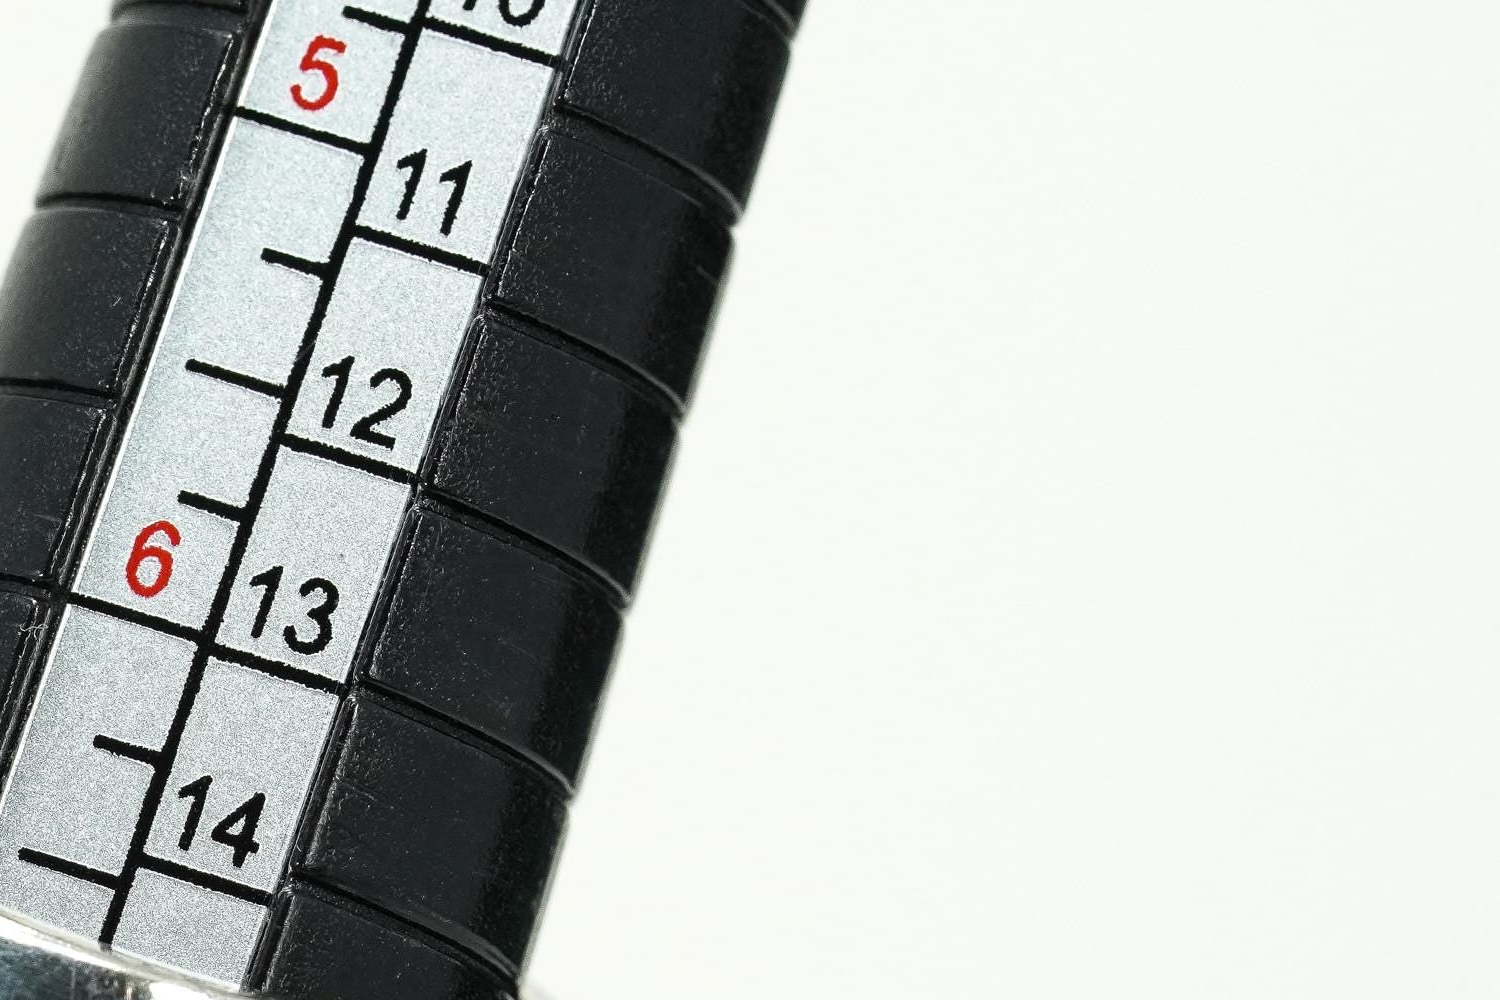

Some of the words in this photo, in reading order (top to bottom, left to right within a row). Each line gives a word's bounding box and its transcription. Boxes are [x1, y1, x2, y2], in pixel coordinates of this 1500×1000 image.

[290, 35, 346, 112] 5
[395, 148, 473, 237] 11
[321, 355, 413, 452] 12
[125, 520, 181, 598] 6
[248, 565, 340, 656] 13
[177, 775, 266, 869] 14
